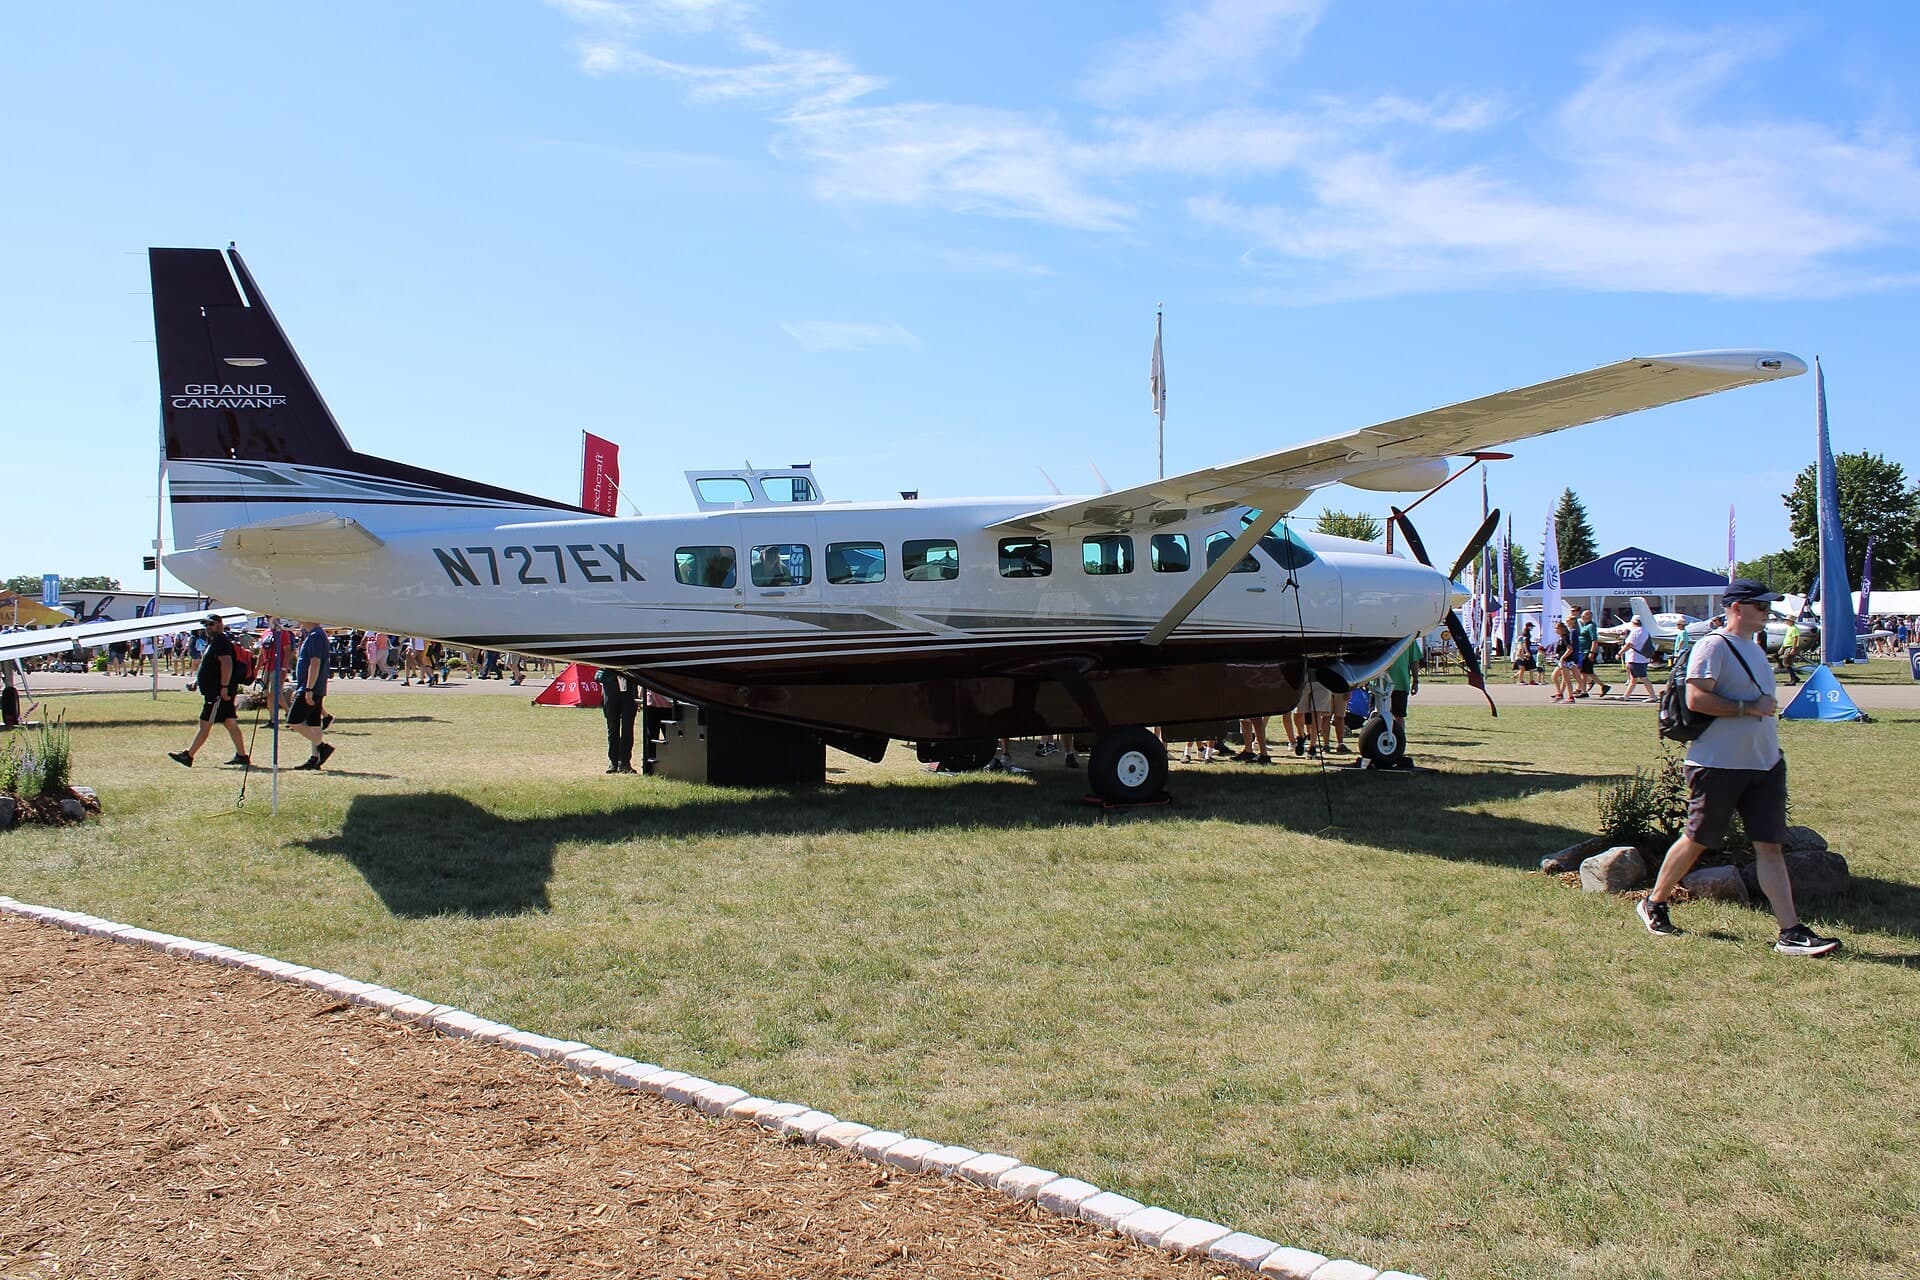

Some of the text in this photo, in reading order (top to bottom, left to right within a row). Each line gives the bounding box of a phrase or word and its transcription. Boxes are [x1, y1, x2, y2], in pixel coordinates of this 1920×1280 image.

[185, 384, 272, 395] GRAND
[594, 454, 604, 512] eechcraft
[432, 543, 646, 586] N727EX
[1621, 561, 1647, 579] TKS
